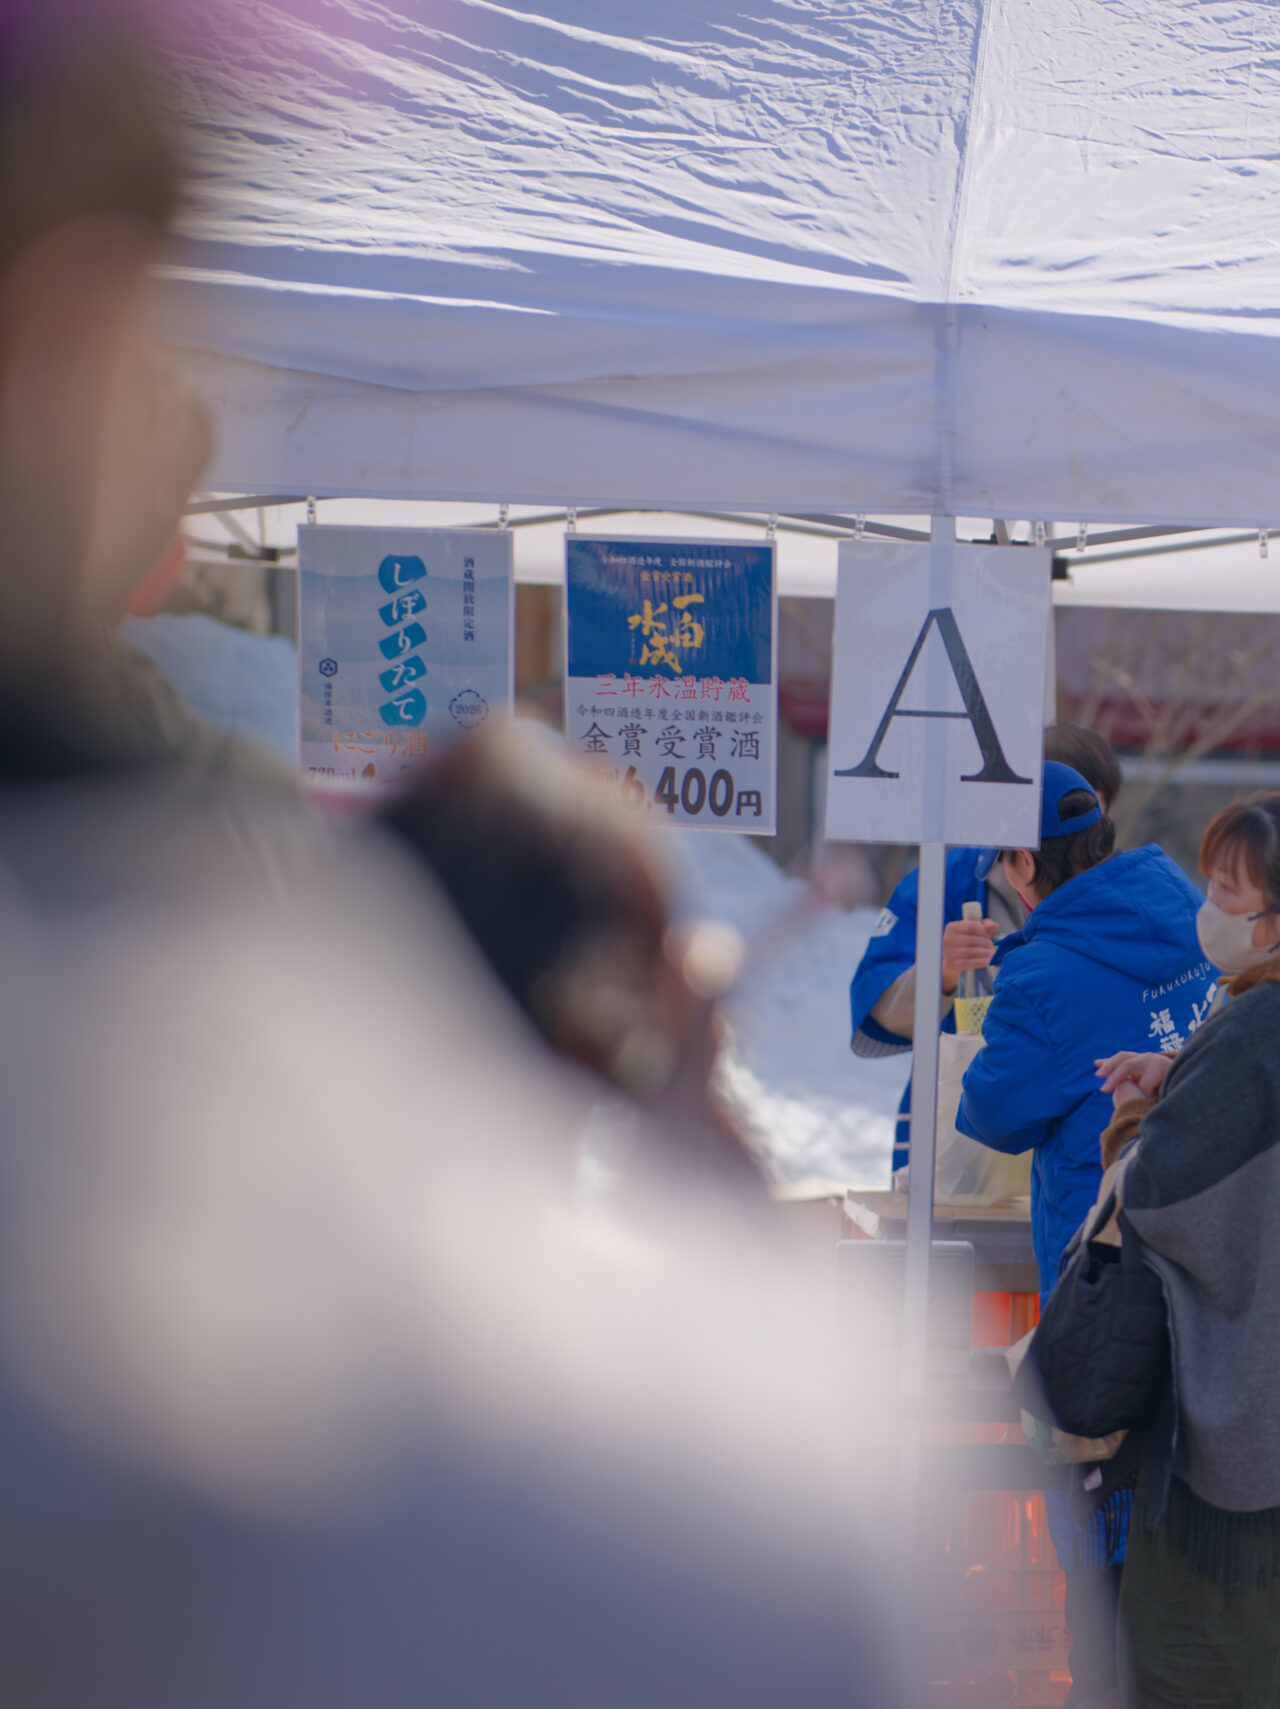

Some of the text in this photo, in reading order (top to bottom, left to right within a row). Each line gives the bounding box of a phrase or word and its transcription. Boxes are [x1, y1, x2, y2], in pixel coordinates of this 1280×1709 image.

[390, 561, 421, 721] しぼりたて
[594, 672, 752, 704] 三年氷温貯蔵
[834, 606, 1034, 785] A
[455, 703, 482, 716] 2026
[576, 703, 765, 725] 令和四酒造年度全国新酒鑑評会
[333, 730, 428, 758] にごり酒
[579, 721, 761, 762] 金賞受賞酒
[621, 764, 762, 818] 6,400円
